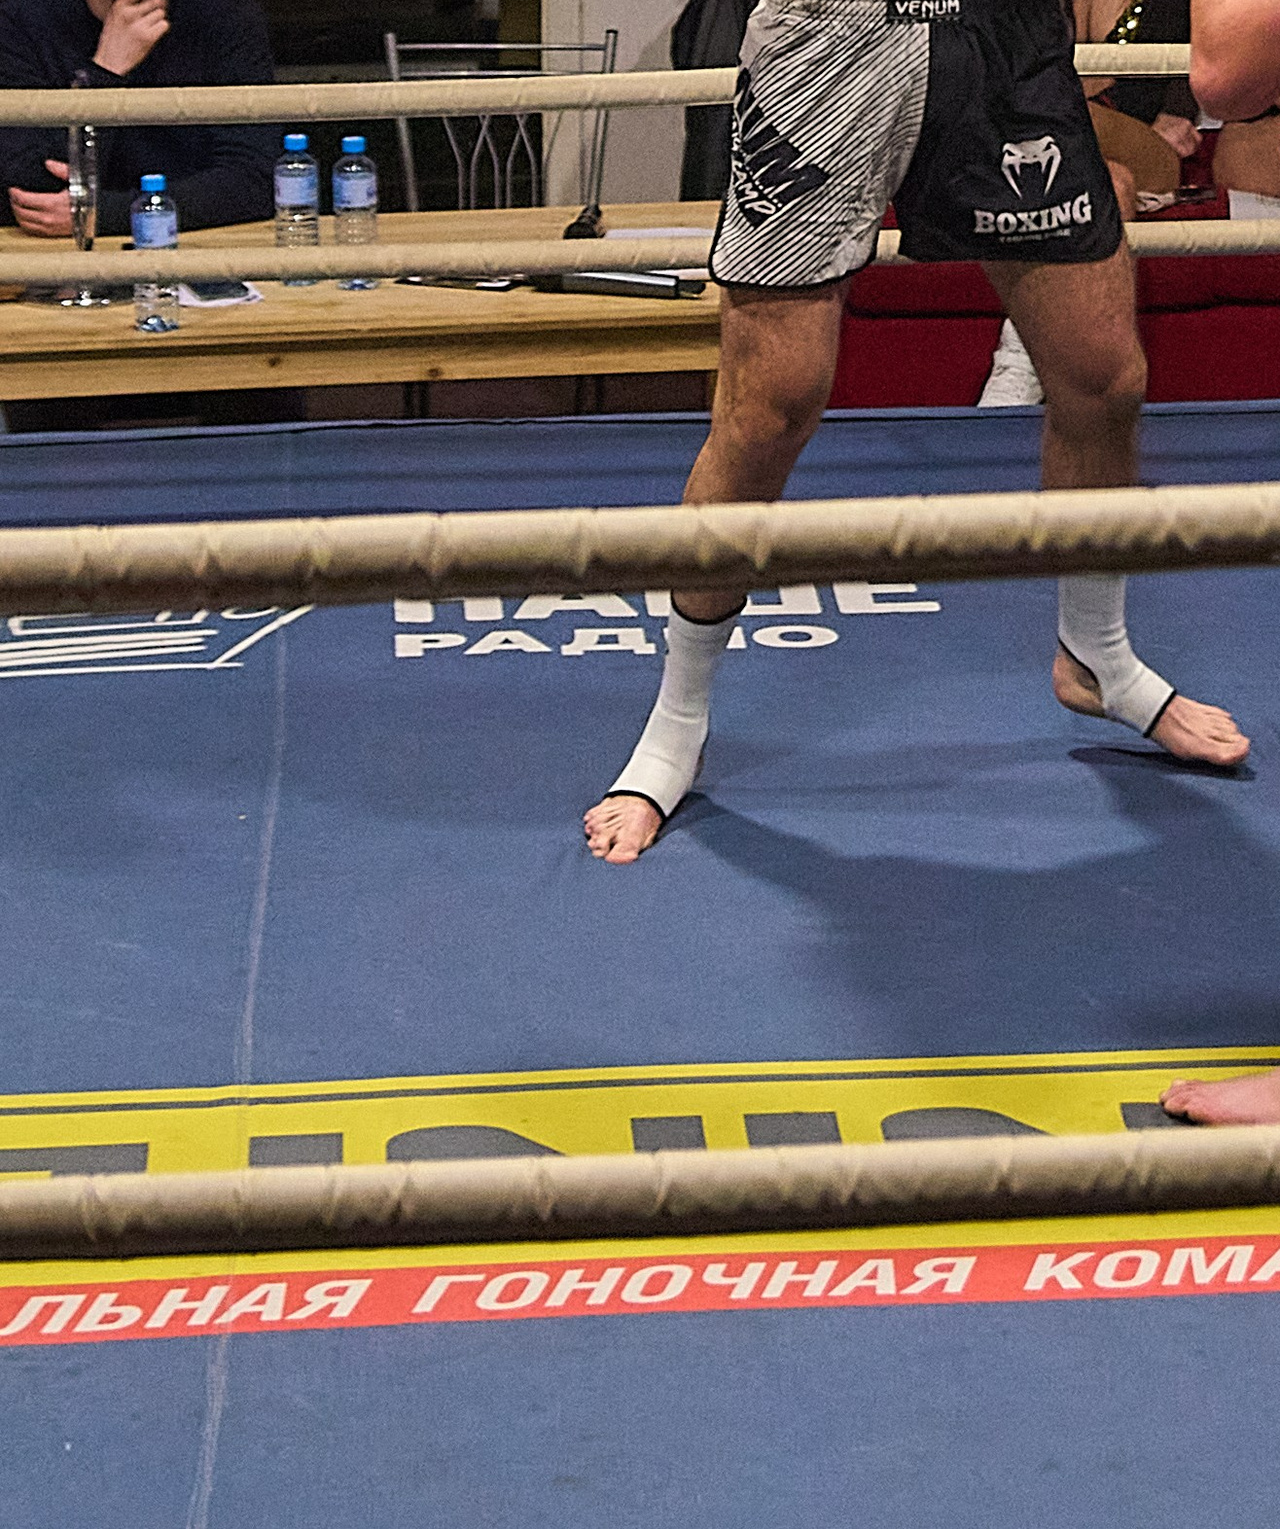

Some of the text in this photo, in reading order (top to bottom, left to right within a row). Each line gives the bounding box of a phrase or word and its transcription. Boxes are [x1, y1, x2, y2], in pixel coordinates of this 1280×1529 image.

[973, 190, 1092, 234] BOXING
[394, 625, 839, 658] РАДО
[410, 1256, 978, 1314] ГОНОЧНАЯ
